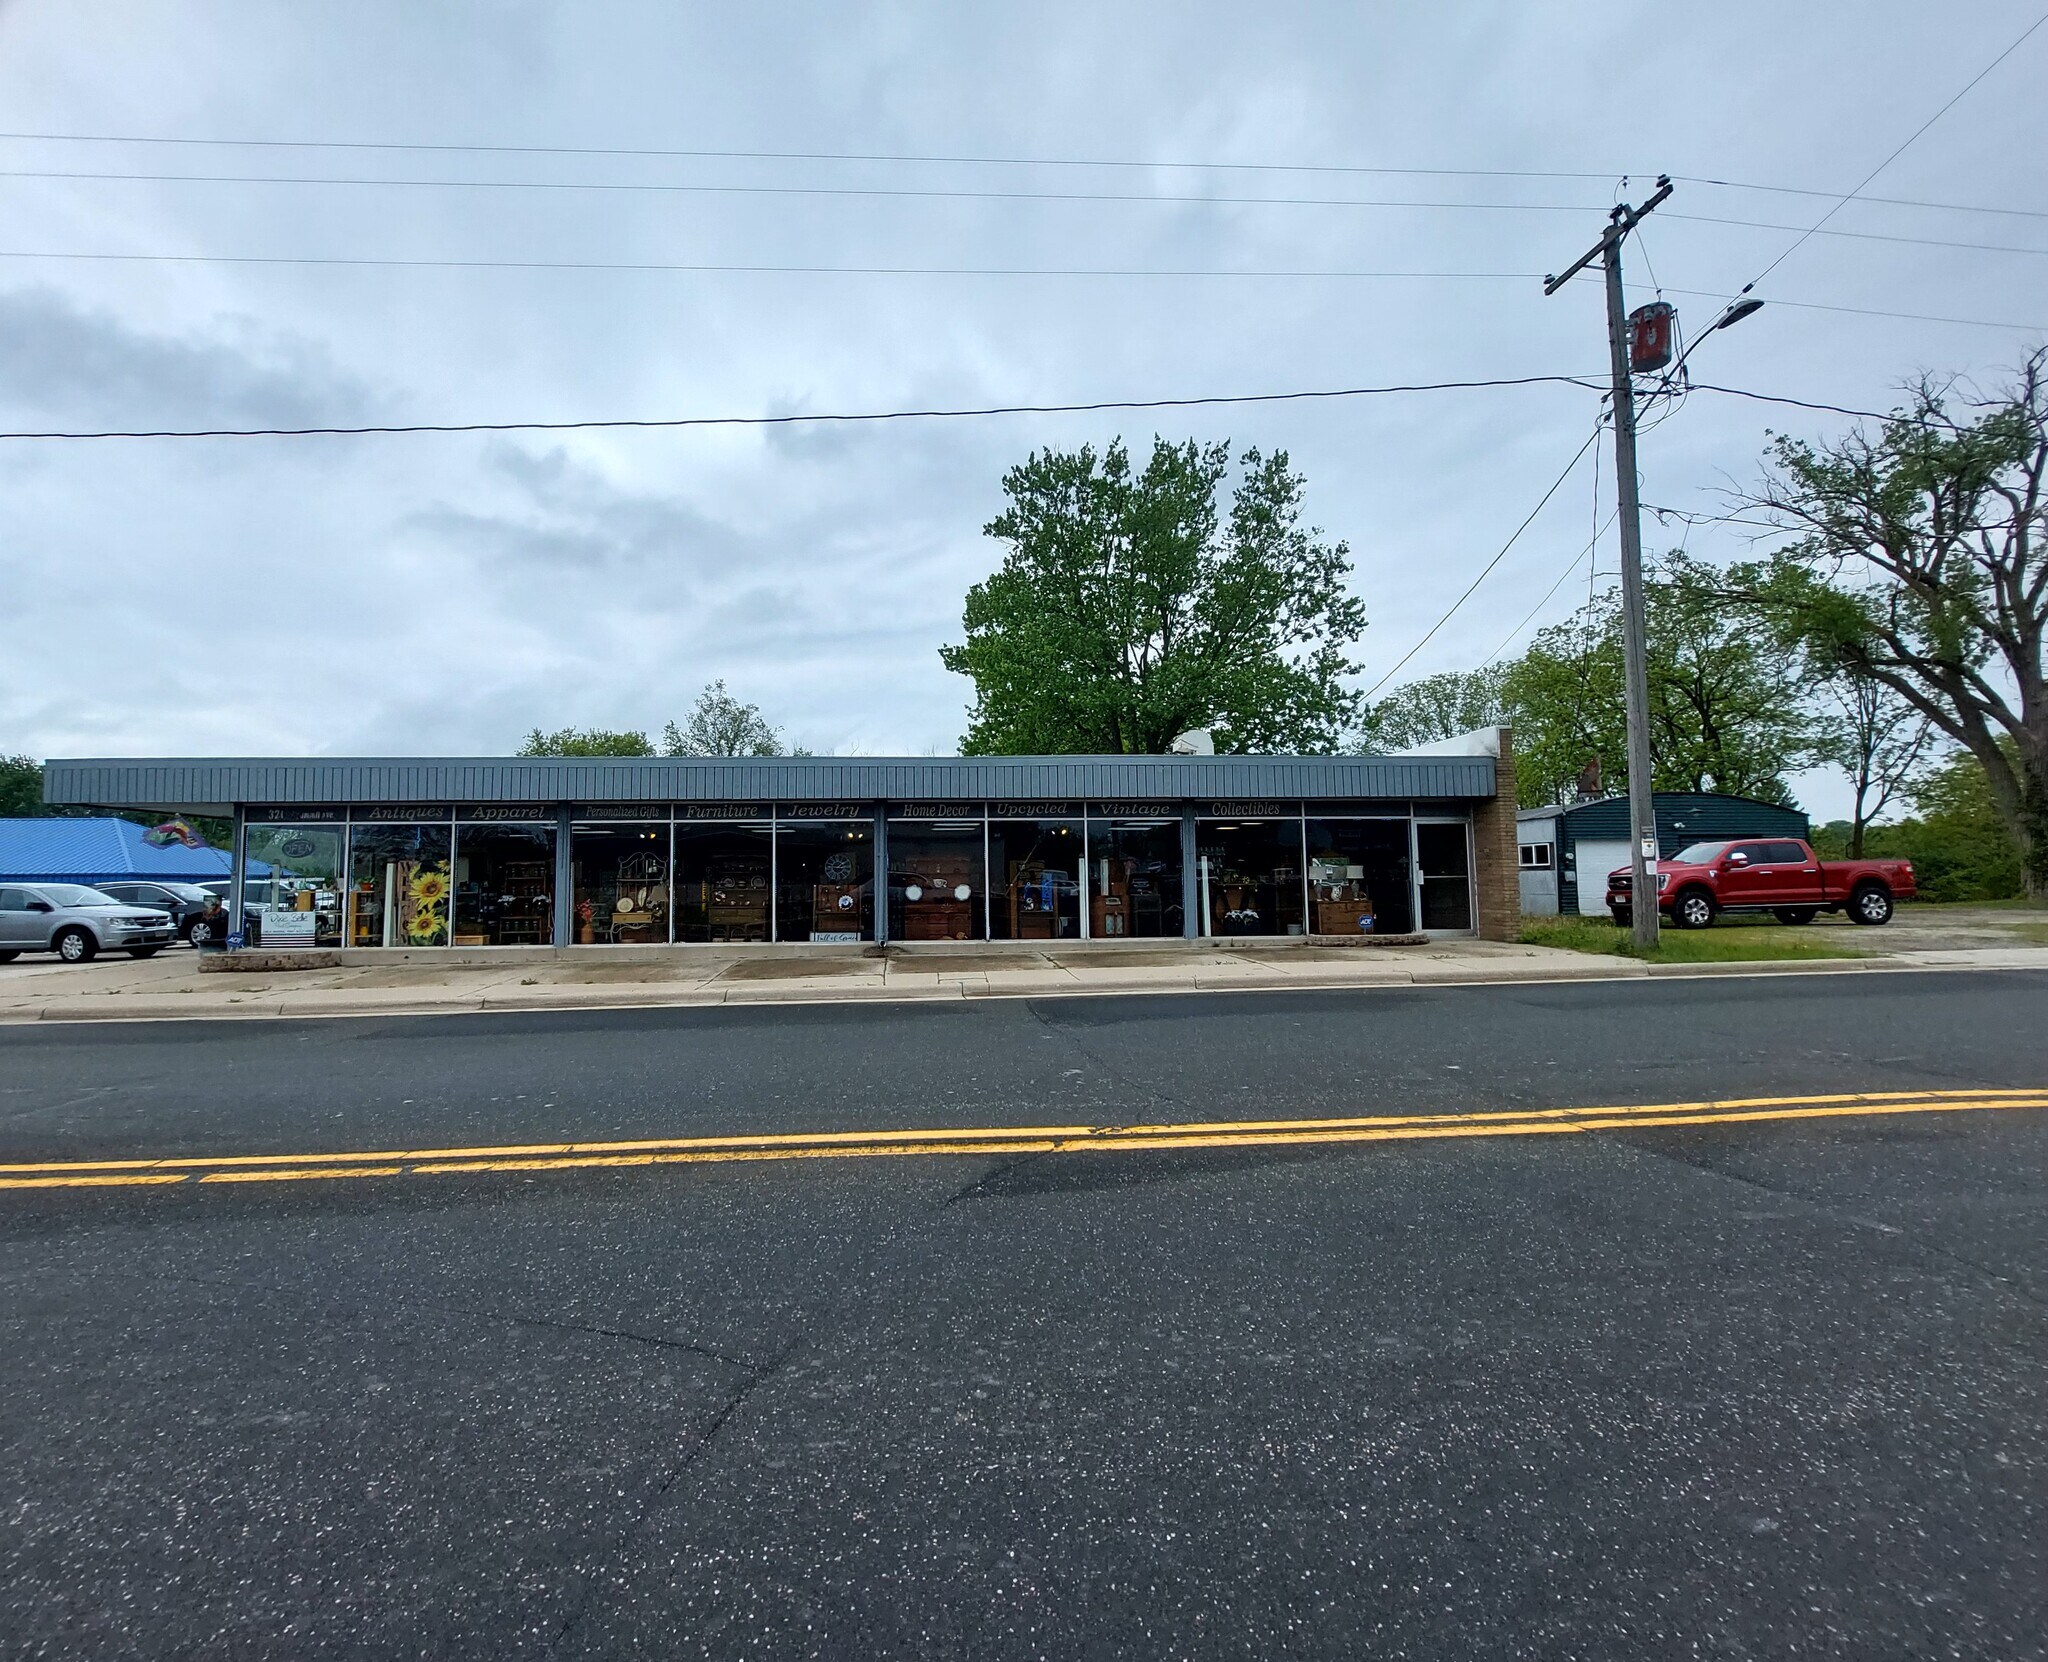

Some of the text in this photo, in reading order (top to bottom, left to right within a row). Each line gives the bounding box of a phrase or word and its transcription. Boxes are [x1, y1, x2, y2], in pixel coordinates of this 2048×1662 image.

[368, 806, 444, 820] Antiques
[471, 806, 545, 819] Apparel
[586, 805, 660, 819] Personalized Gifts
[686, 804, 759, 818] Furniture
[787, 804, 860, 818] Jewelry
[902, 804, 970, 817] Home Decor
[996, 803, 1067, 816] Upcycled
[1100, 803, 1171, 816] Vintage
[1211, 802, 1281, 816] Collectibles
[227, 936, 243, 944] ADT
